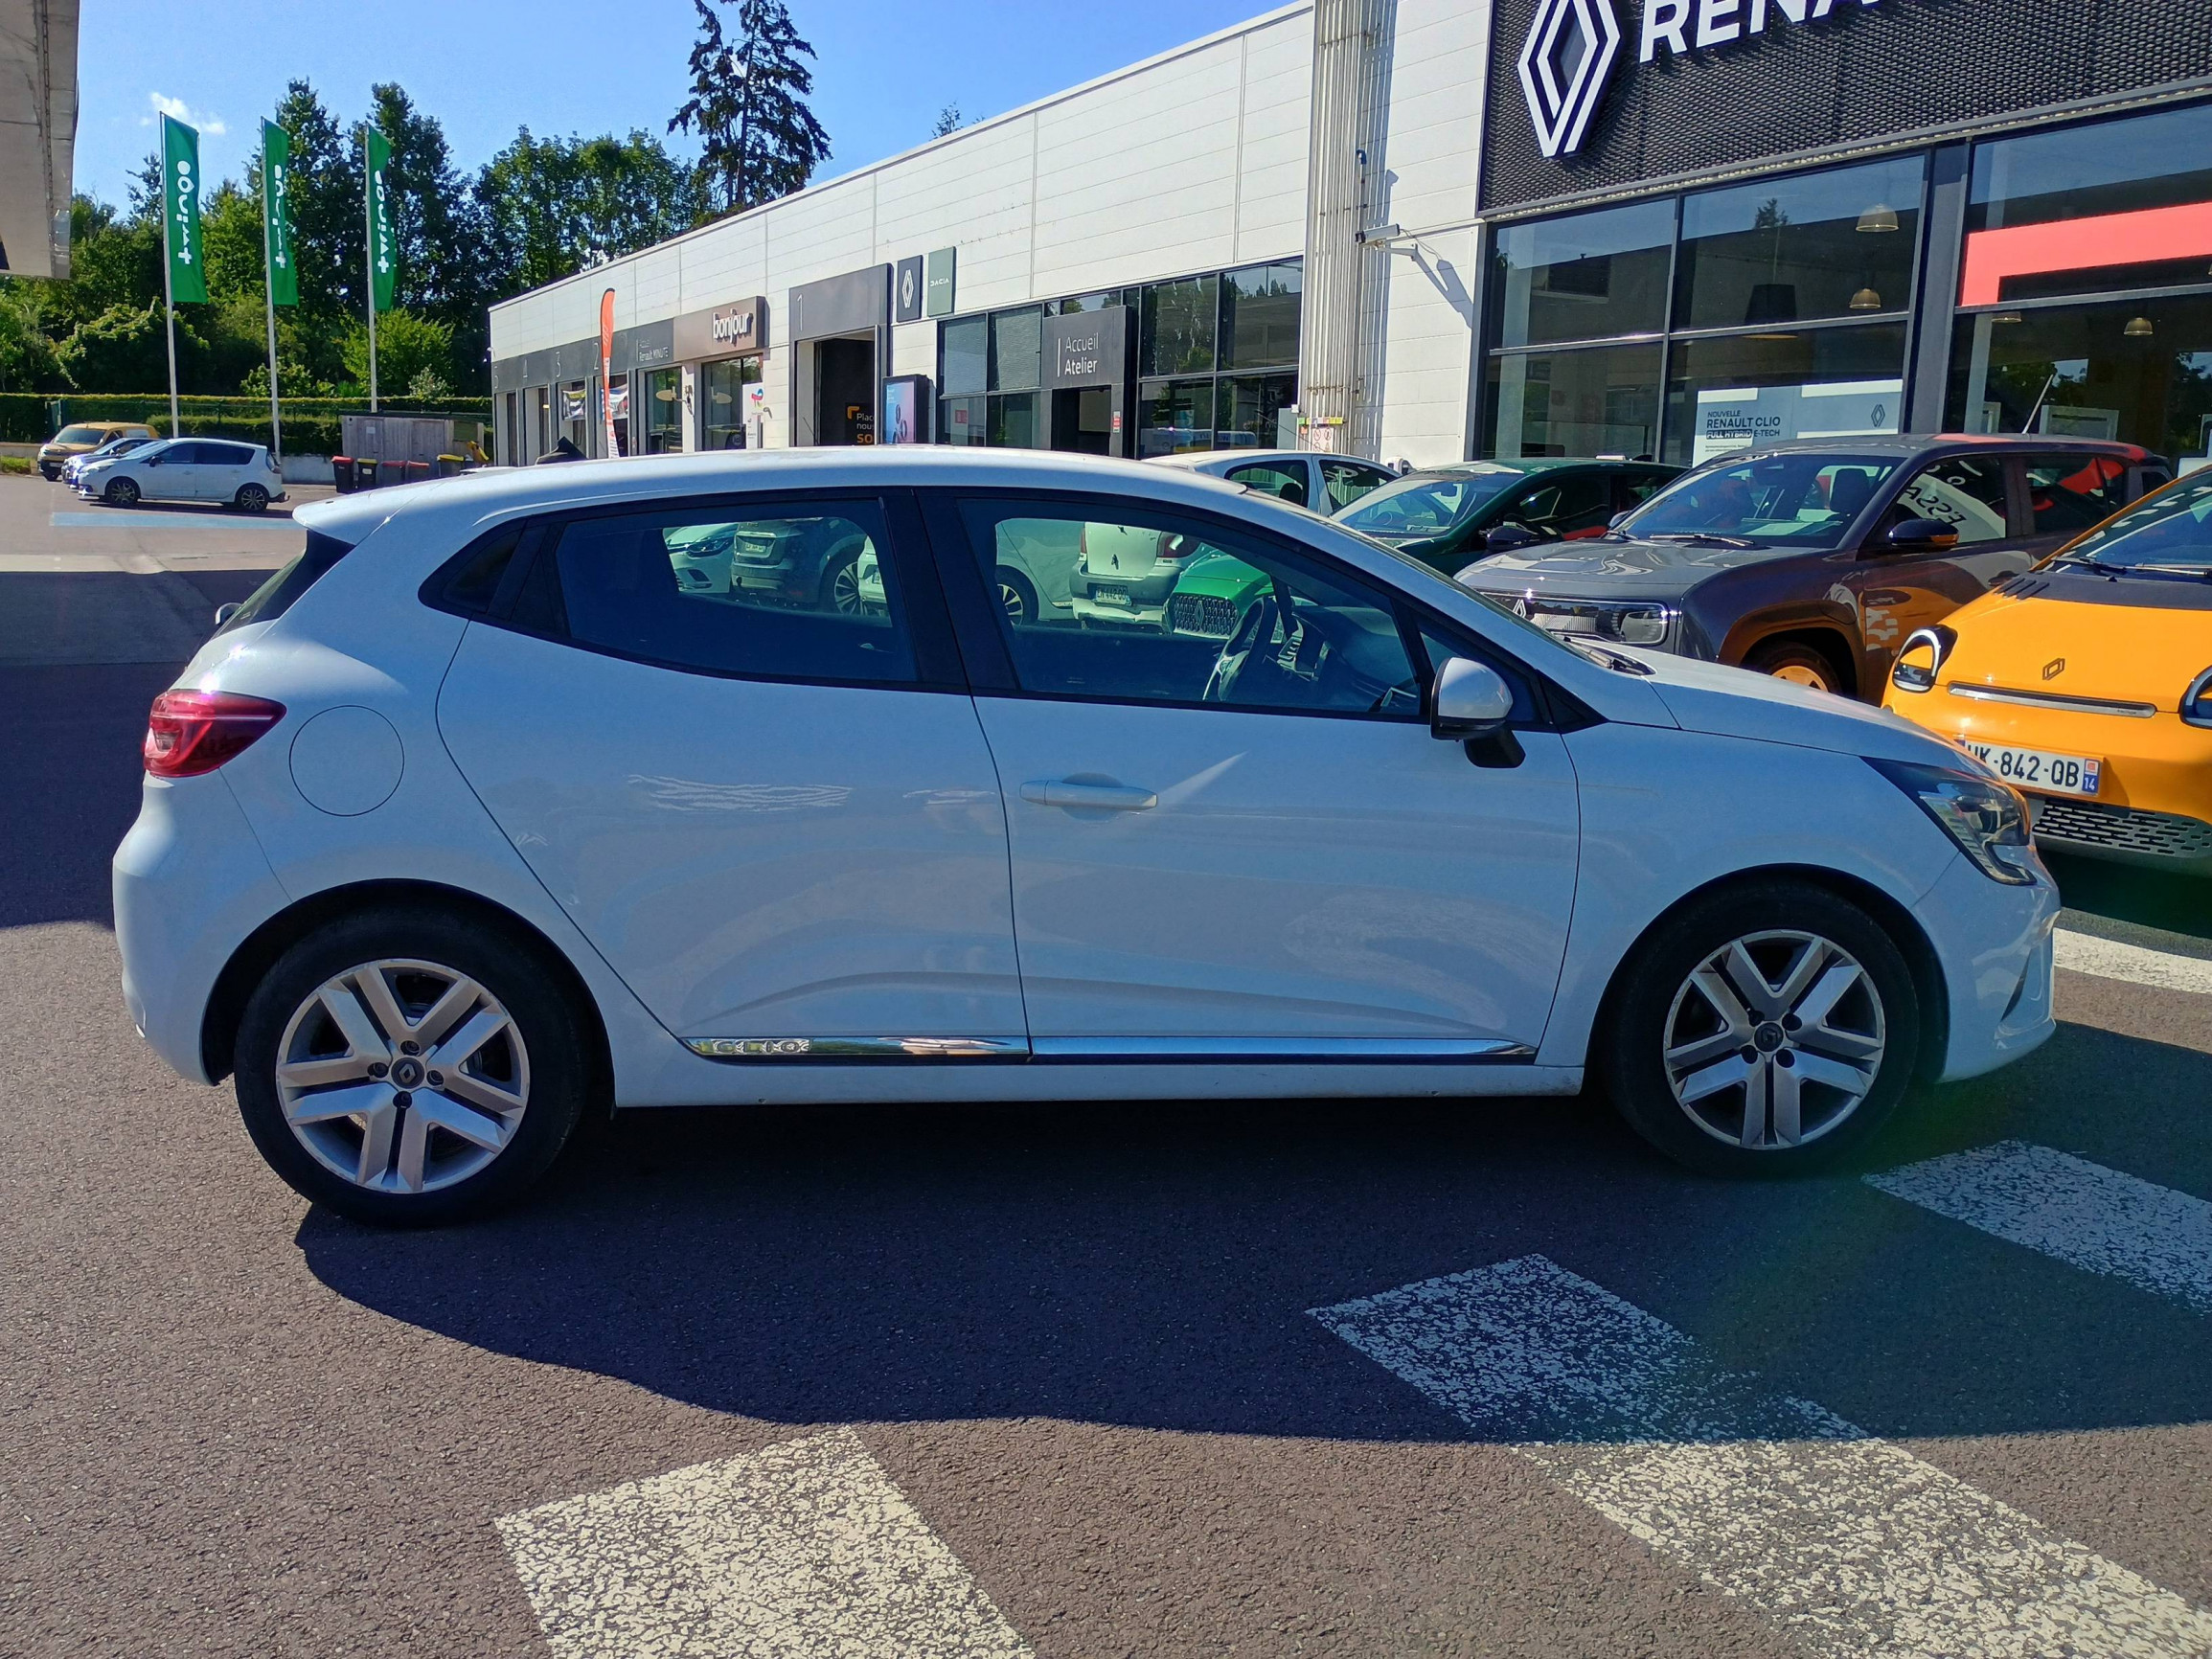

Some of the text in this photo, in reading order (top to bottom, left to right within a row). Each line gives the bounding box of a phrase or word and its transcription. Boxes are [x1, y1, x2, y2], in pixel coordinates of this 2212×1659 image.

[1639, 0, 1879, 63] RE
[929, 278, 950, 287] DACIA
[797, 294, 804, 332] 1
[712, 308, 751, 344] bonjour
[1064, 332, 1099, 353] Accueil
[1064, 357, 1098, 376] Atelier
[1706, 417, 1781, 428] RENAULT CLIO
[1706, 430, 1723, 439] FULL
[1724, 429, 1752, 439] HYBRID
[2084, 776, 2096, 790] 14
